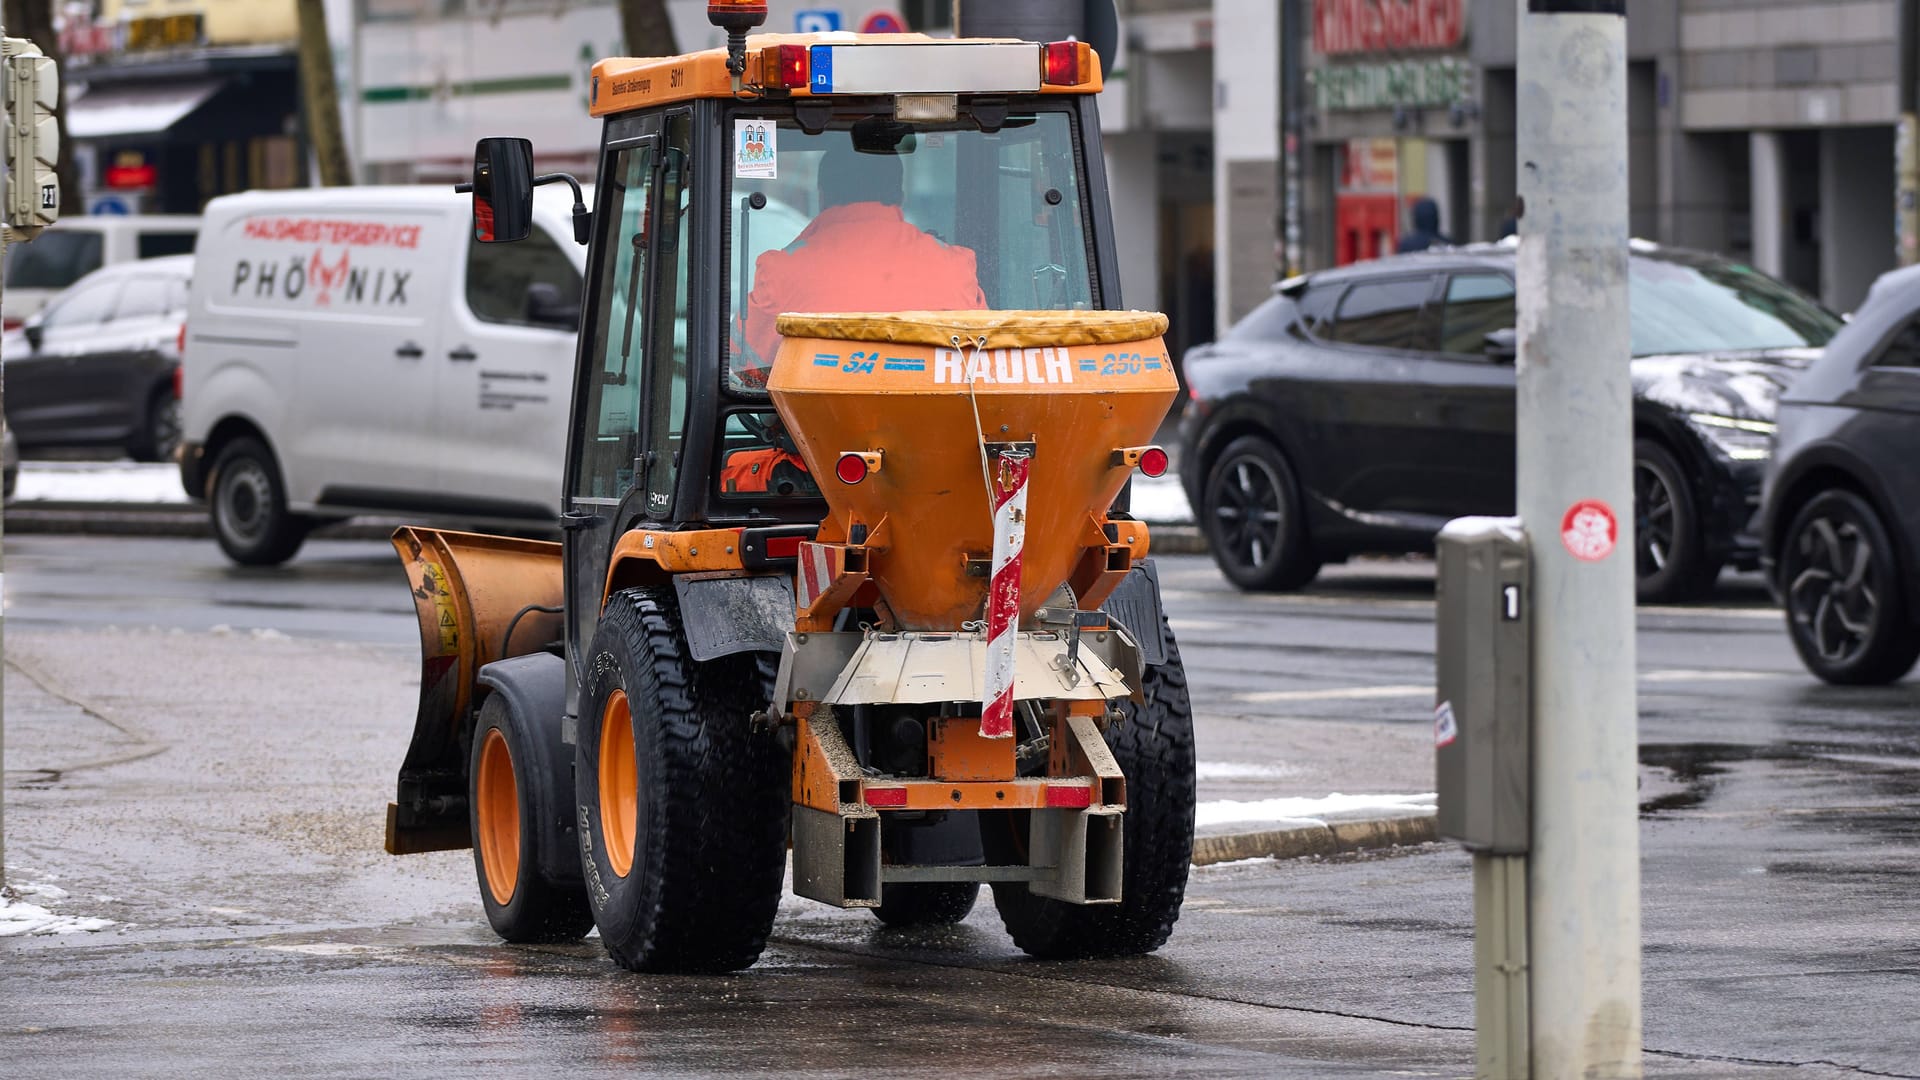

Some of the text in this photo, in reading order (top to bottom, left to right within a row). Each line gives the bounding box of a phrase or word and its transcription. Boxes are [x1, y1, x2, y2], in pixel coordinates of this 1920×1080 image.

[671, 67, 684, 88] 5011
[818, 74, 826, 84] D
[243, 217, 422, 250] HAUSMEISTERSERVICE
[842, 351, 880, 374] SA
[934, 347, 1073, 384] RAUCH
[1100, 353, 1141, 376] 250
[1505, 586, 1518, 618] 1
